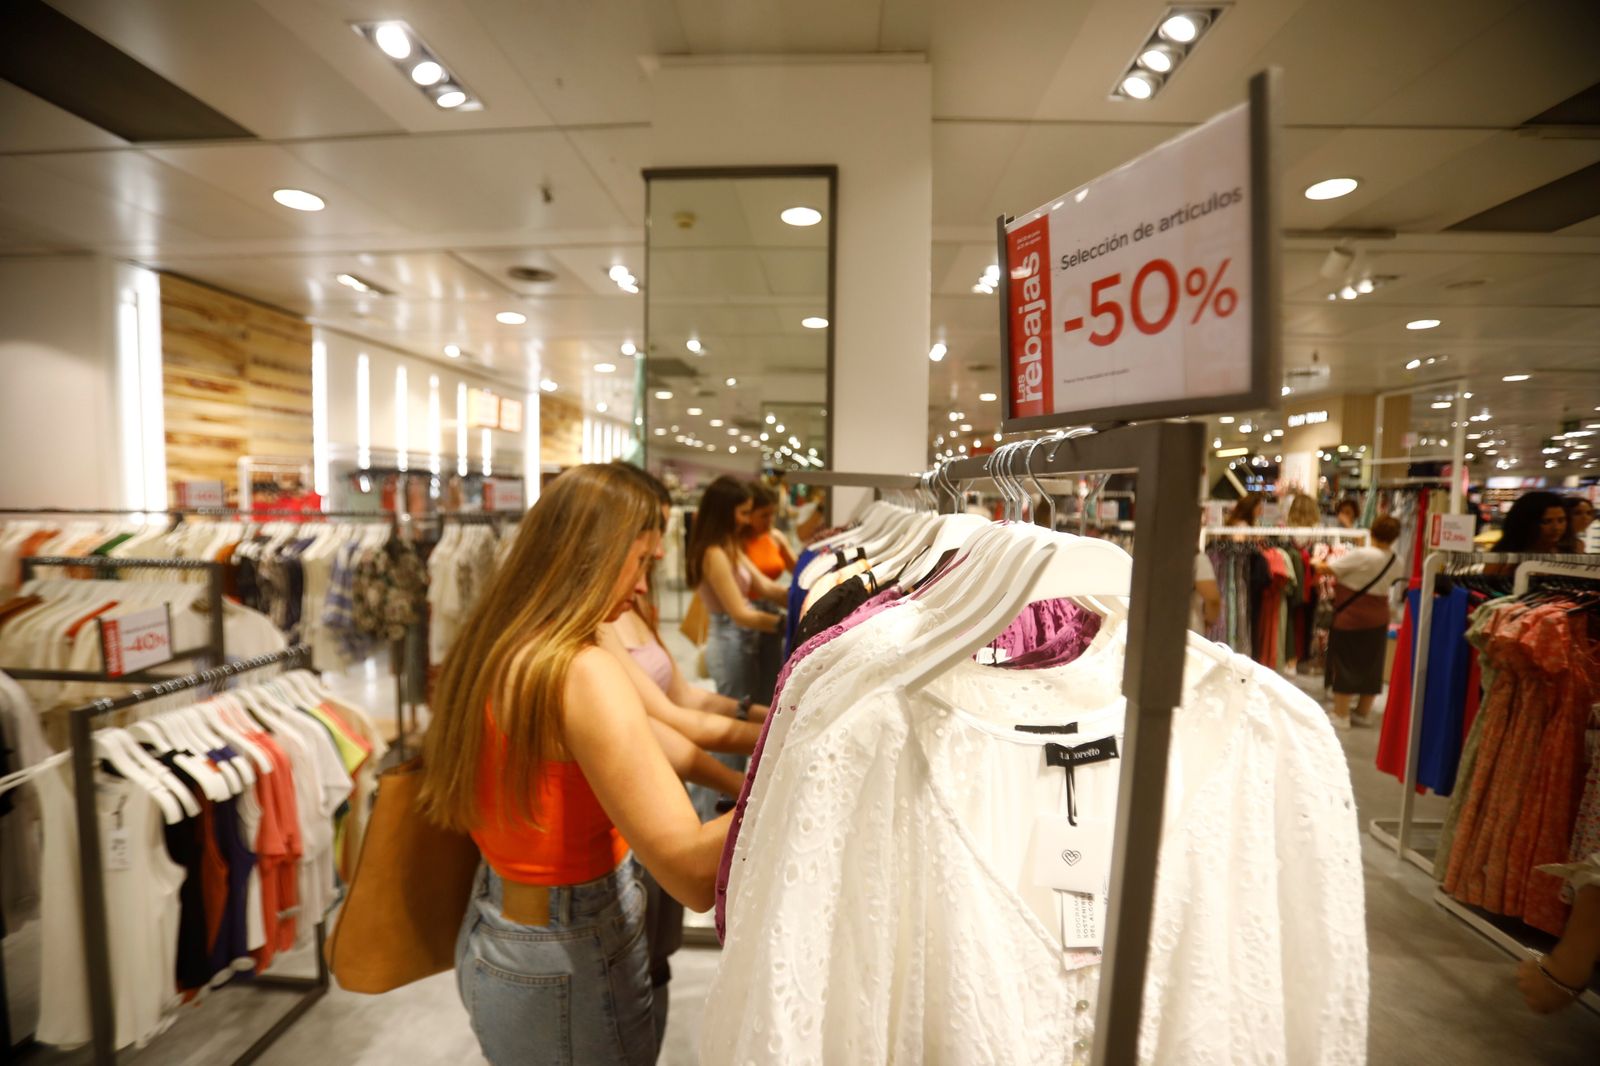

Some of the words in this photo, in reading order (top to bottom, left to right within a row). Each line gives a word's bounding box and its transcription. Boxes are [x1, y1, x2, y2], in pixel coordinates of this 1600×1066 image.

[1060, 231, 1129, 271] Selección
[1132, 221, 1155, 242] de
[1159, 186, 1244, 233] artículos
[1018, 251, 1046, 402] rebajas
[1063, 256, 1240, 348] -50%
[1016, 373, 1026, 404] Las
